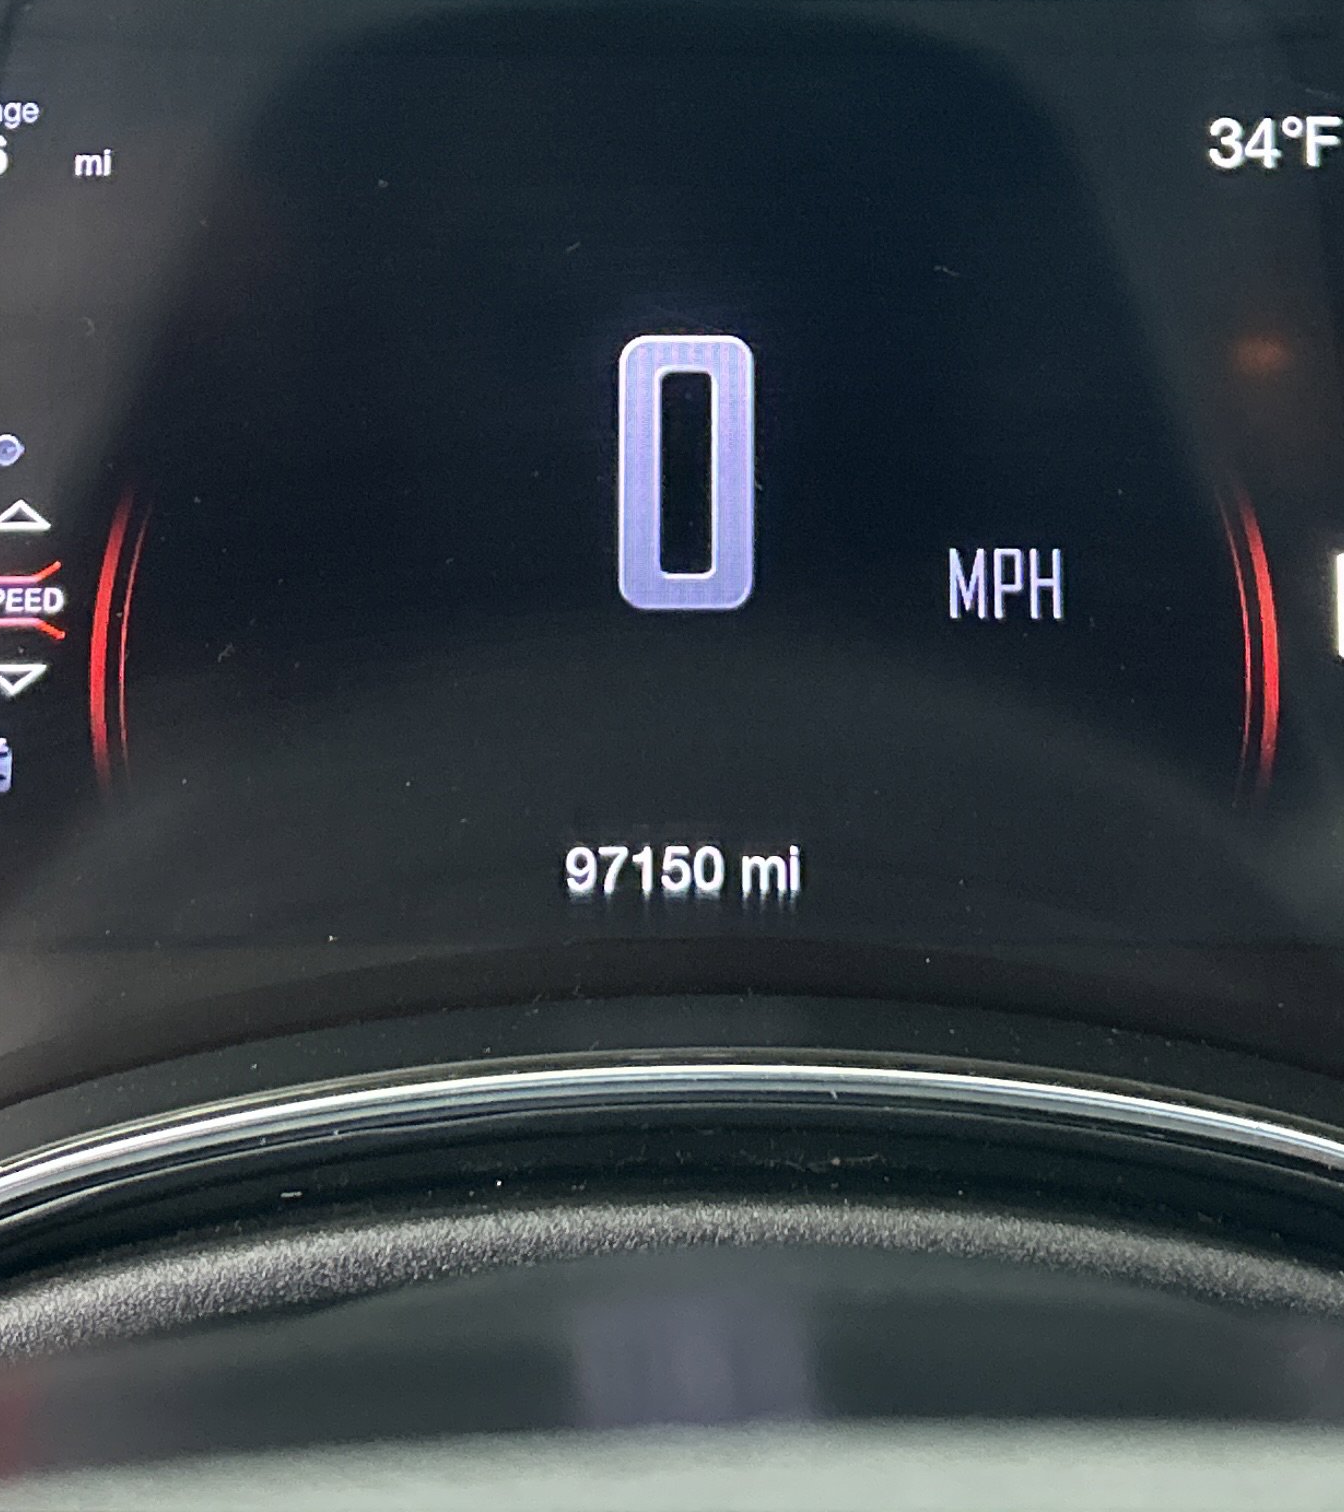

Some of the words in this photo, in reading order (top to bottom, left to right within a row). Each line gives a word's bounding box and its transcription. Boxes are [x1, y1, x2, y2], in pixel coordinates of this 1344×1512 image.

[74, 149, 112, 176] mi
[1207, 115, 1344, 170] 34°F
[619, 334, 755, 610] 0
[948, 548, 1064, 620] MPH
[564, 845, 725, 894] 97150
[741, 845, 802, 894] mi
